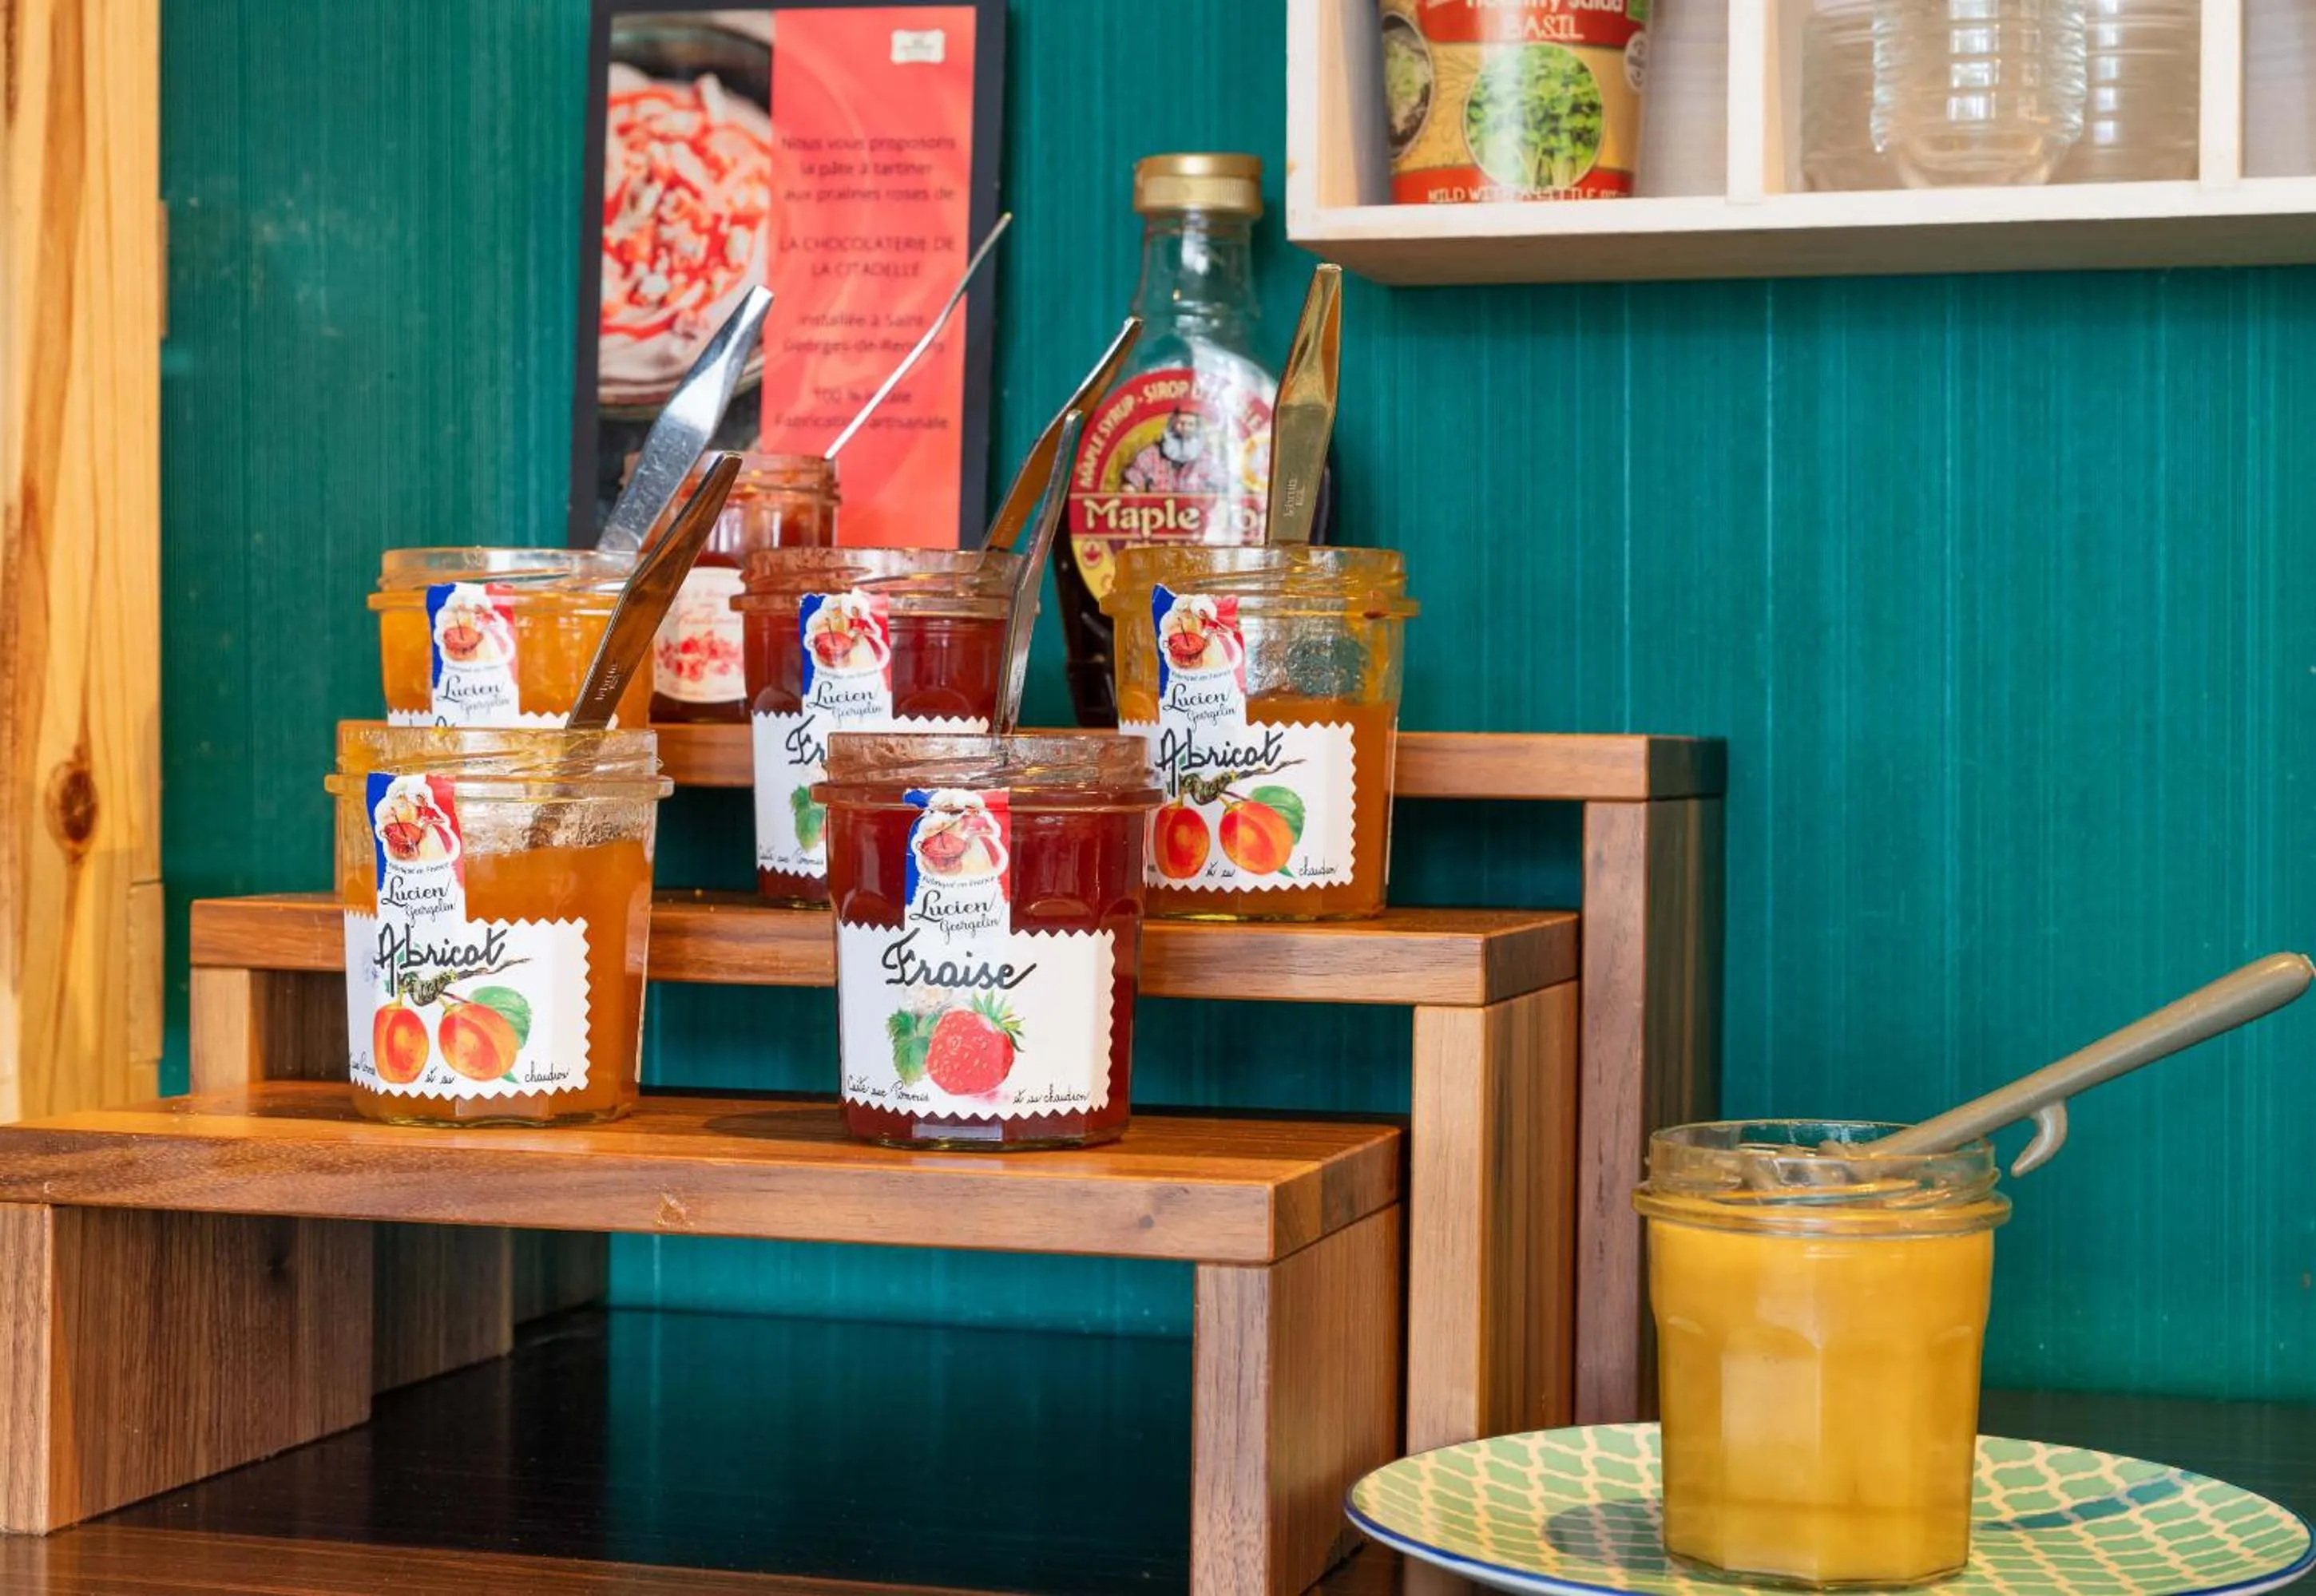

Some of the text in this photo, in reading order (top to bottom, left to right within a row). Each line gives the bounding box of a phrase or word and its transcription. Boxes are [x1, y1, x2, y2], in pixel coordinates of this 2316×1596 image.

[781, 137, 956, 154] Nous vous proposons
[818, 161, 855, 179] pâte
[873, 162, 933, 175] tartiner
[816, 186, 881, 204] pralines
[885, 188, 930, 200] roses
[779, 236, 955, 252] LA CHOCOLATERIE DE
[811, 261, 920, 278] LA CITADELLE
[1143, 378, 1190, 405] SIROP
[869, 414, 949, 430] artisanale
[1078, 394, 1135, 489] MAPLE SYRUP
[1084, 497, 1201, 539] Maple
[435, 674, 504, 703] Lucien
[805, 680, 878, 711] Lucien
[1162, 683, 1231, 713] Lucien
[1154, 727, 1284, 797] Abricot
[380, 875, 452, 908] Lucien
[909, 889, 997, 923] Lucien
[372, 922, 508, 998] Abricot
[881, 927, 1038, 990] Fraise
